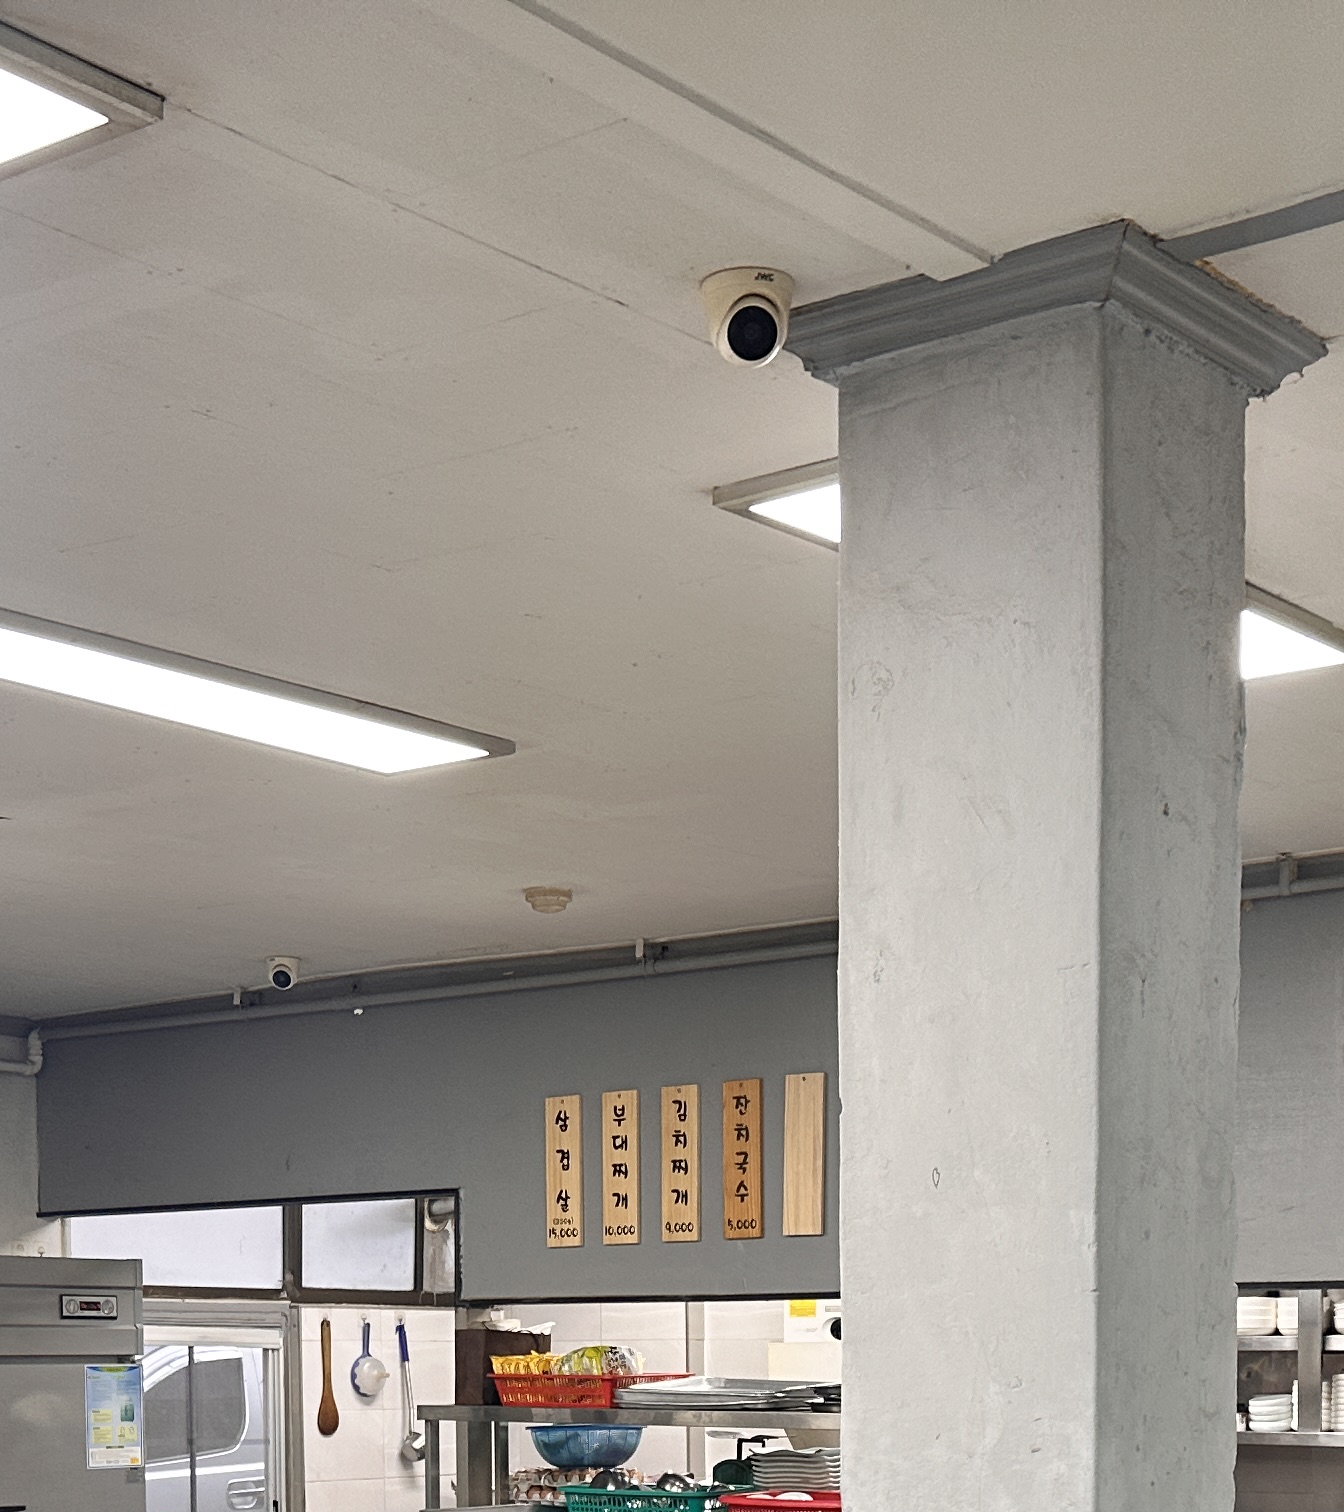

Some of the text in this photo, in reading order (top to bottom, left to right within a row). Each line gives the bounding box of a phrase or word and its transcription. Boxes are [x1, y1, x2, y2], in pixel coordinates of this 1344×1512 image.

[670, 1099, 689, 1207] 김치찌개
[731, 1094, 750, 1204] 잔치국수
[611, 1104, 629, 1210] 부대찌개
[604, 1225, 636, 1237] 10,000
[665, 1221, 694, 1234] 9,000
[727, 1218, 757, 1231] 5,000
[548, 1227, 579, 1240] 15,000
